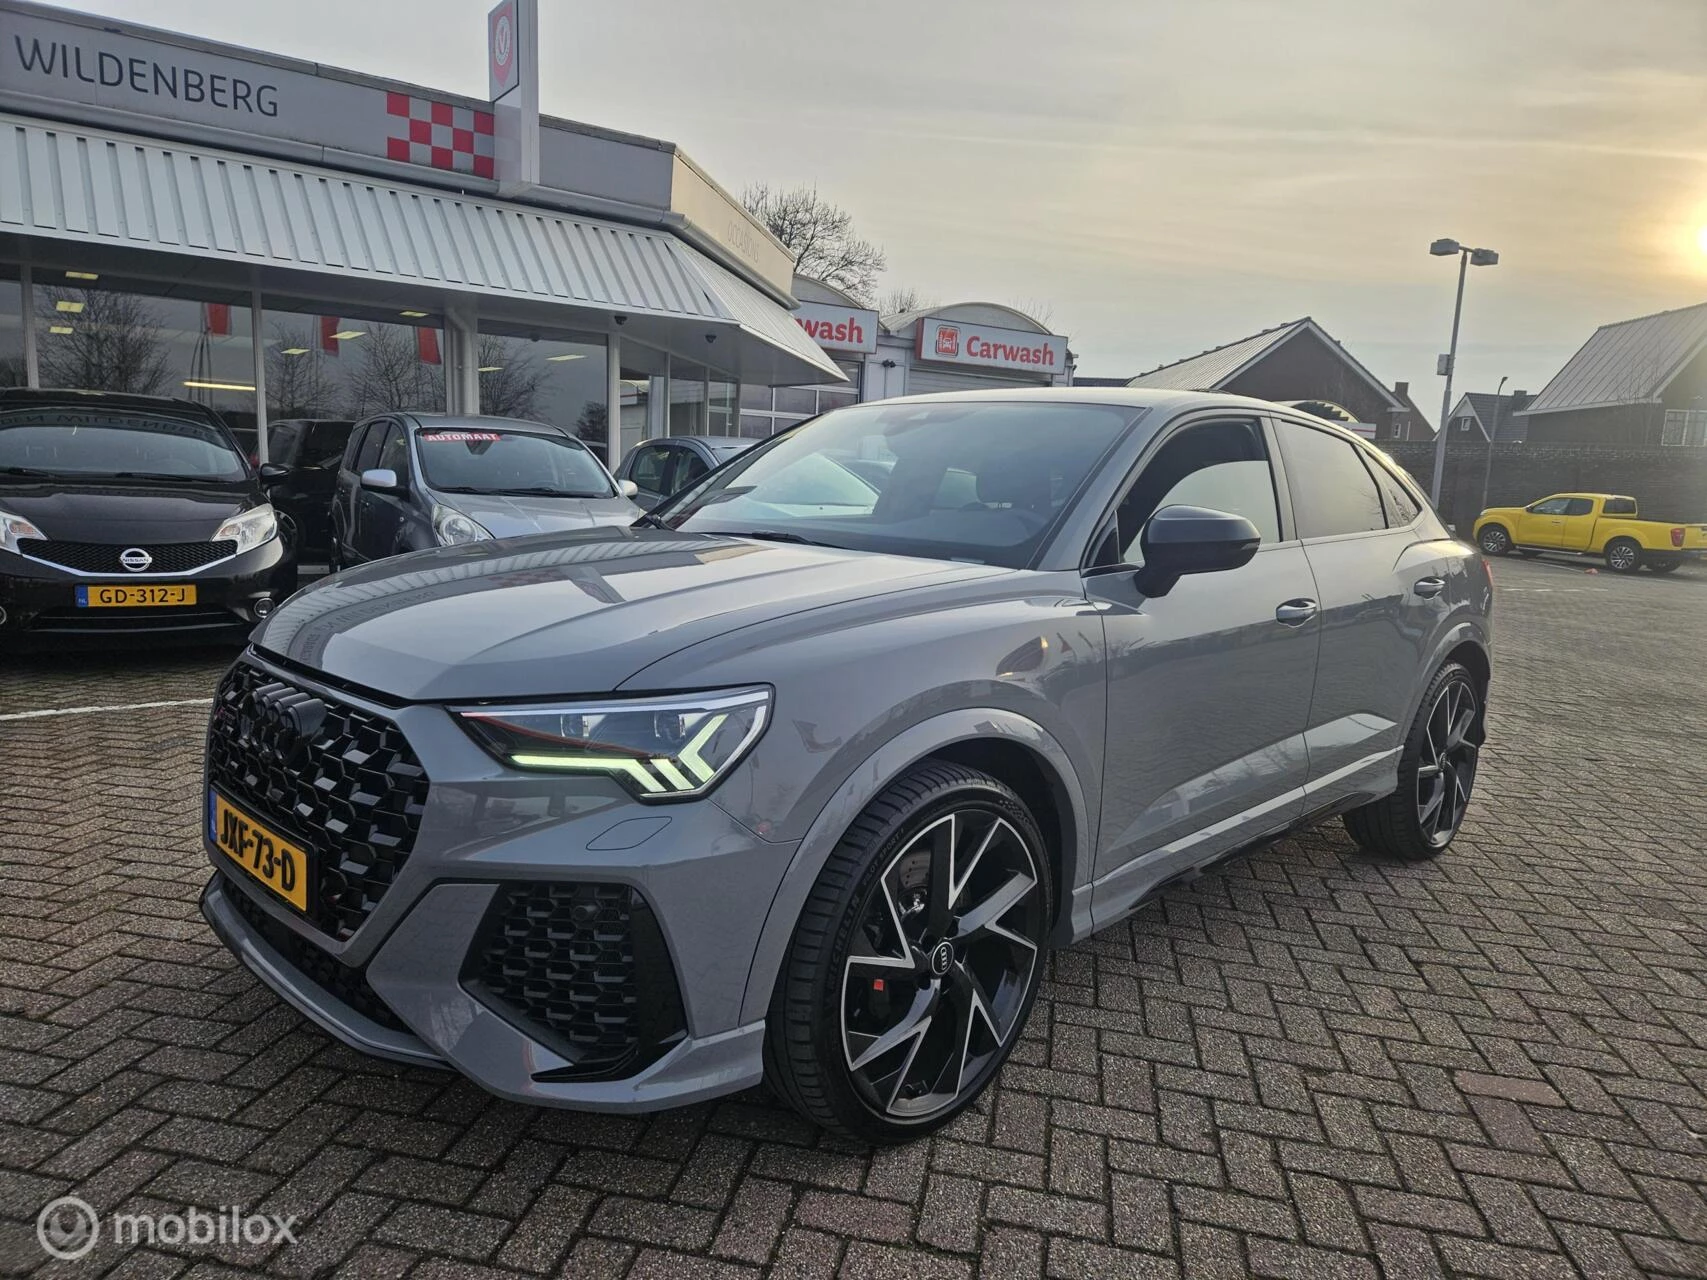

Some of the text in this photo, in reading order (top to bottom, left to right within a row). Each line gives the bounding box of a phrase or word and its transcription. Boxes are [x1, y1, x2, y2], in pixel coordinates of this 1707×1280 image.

[14, 35, 278, 117] WILDENBERG
[966, 335, 1054, 366] Carwash
[427, 432, 497, 441] AUTOMAAT
[99, 588, 185, 604] GD-312-J
[220, 808, 296, 892] JXF-73-D
